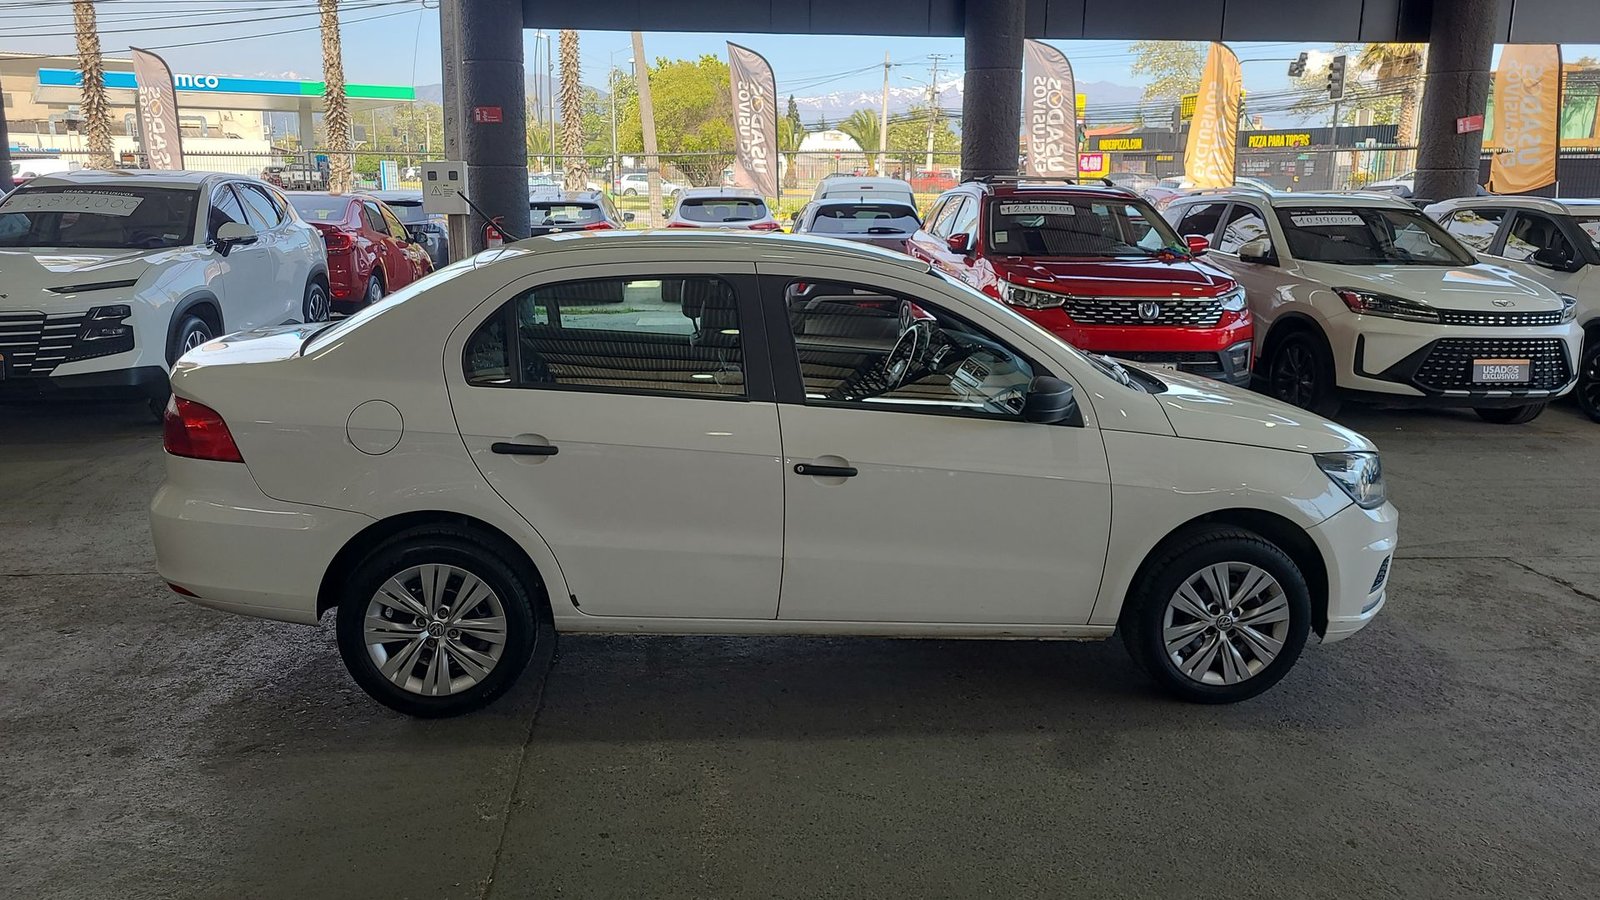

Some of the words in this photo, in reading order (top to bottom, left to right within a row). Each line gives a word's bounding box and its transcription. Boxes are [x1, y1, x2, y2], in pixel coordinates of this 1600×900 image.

[175, 74, 219, 88] mco
[1248, 135, 1267, 148] PIZZA
[1267, 134, 1285, 147] PARA
[1482, 365, 1520, 374] USADOS
